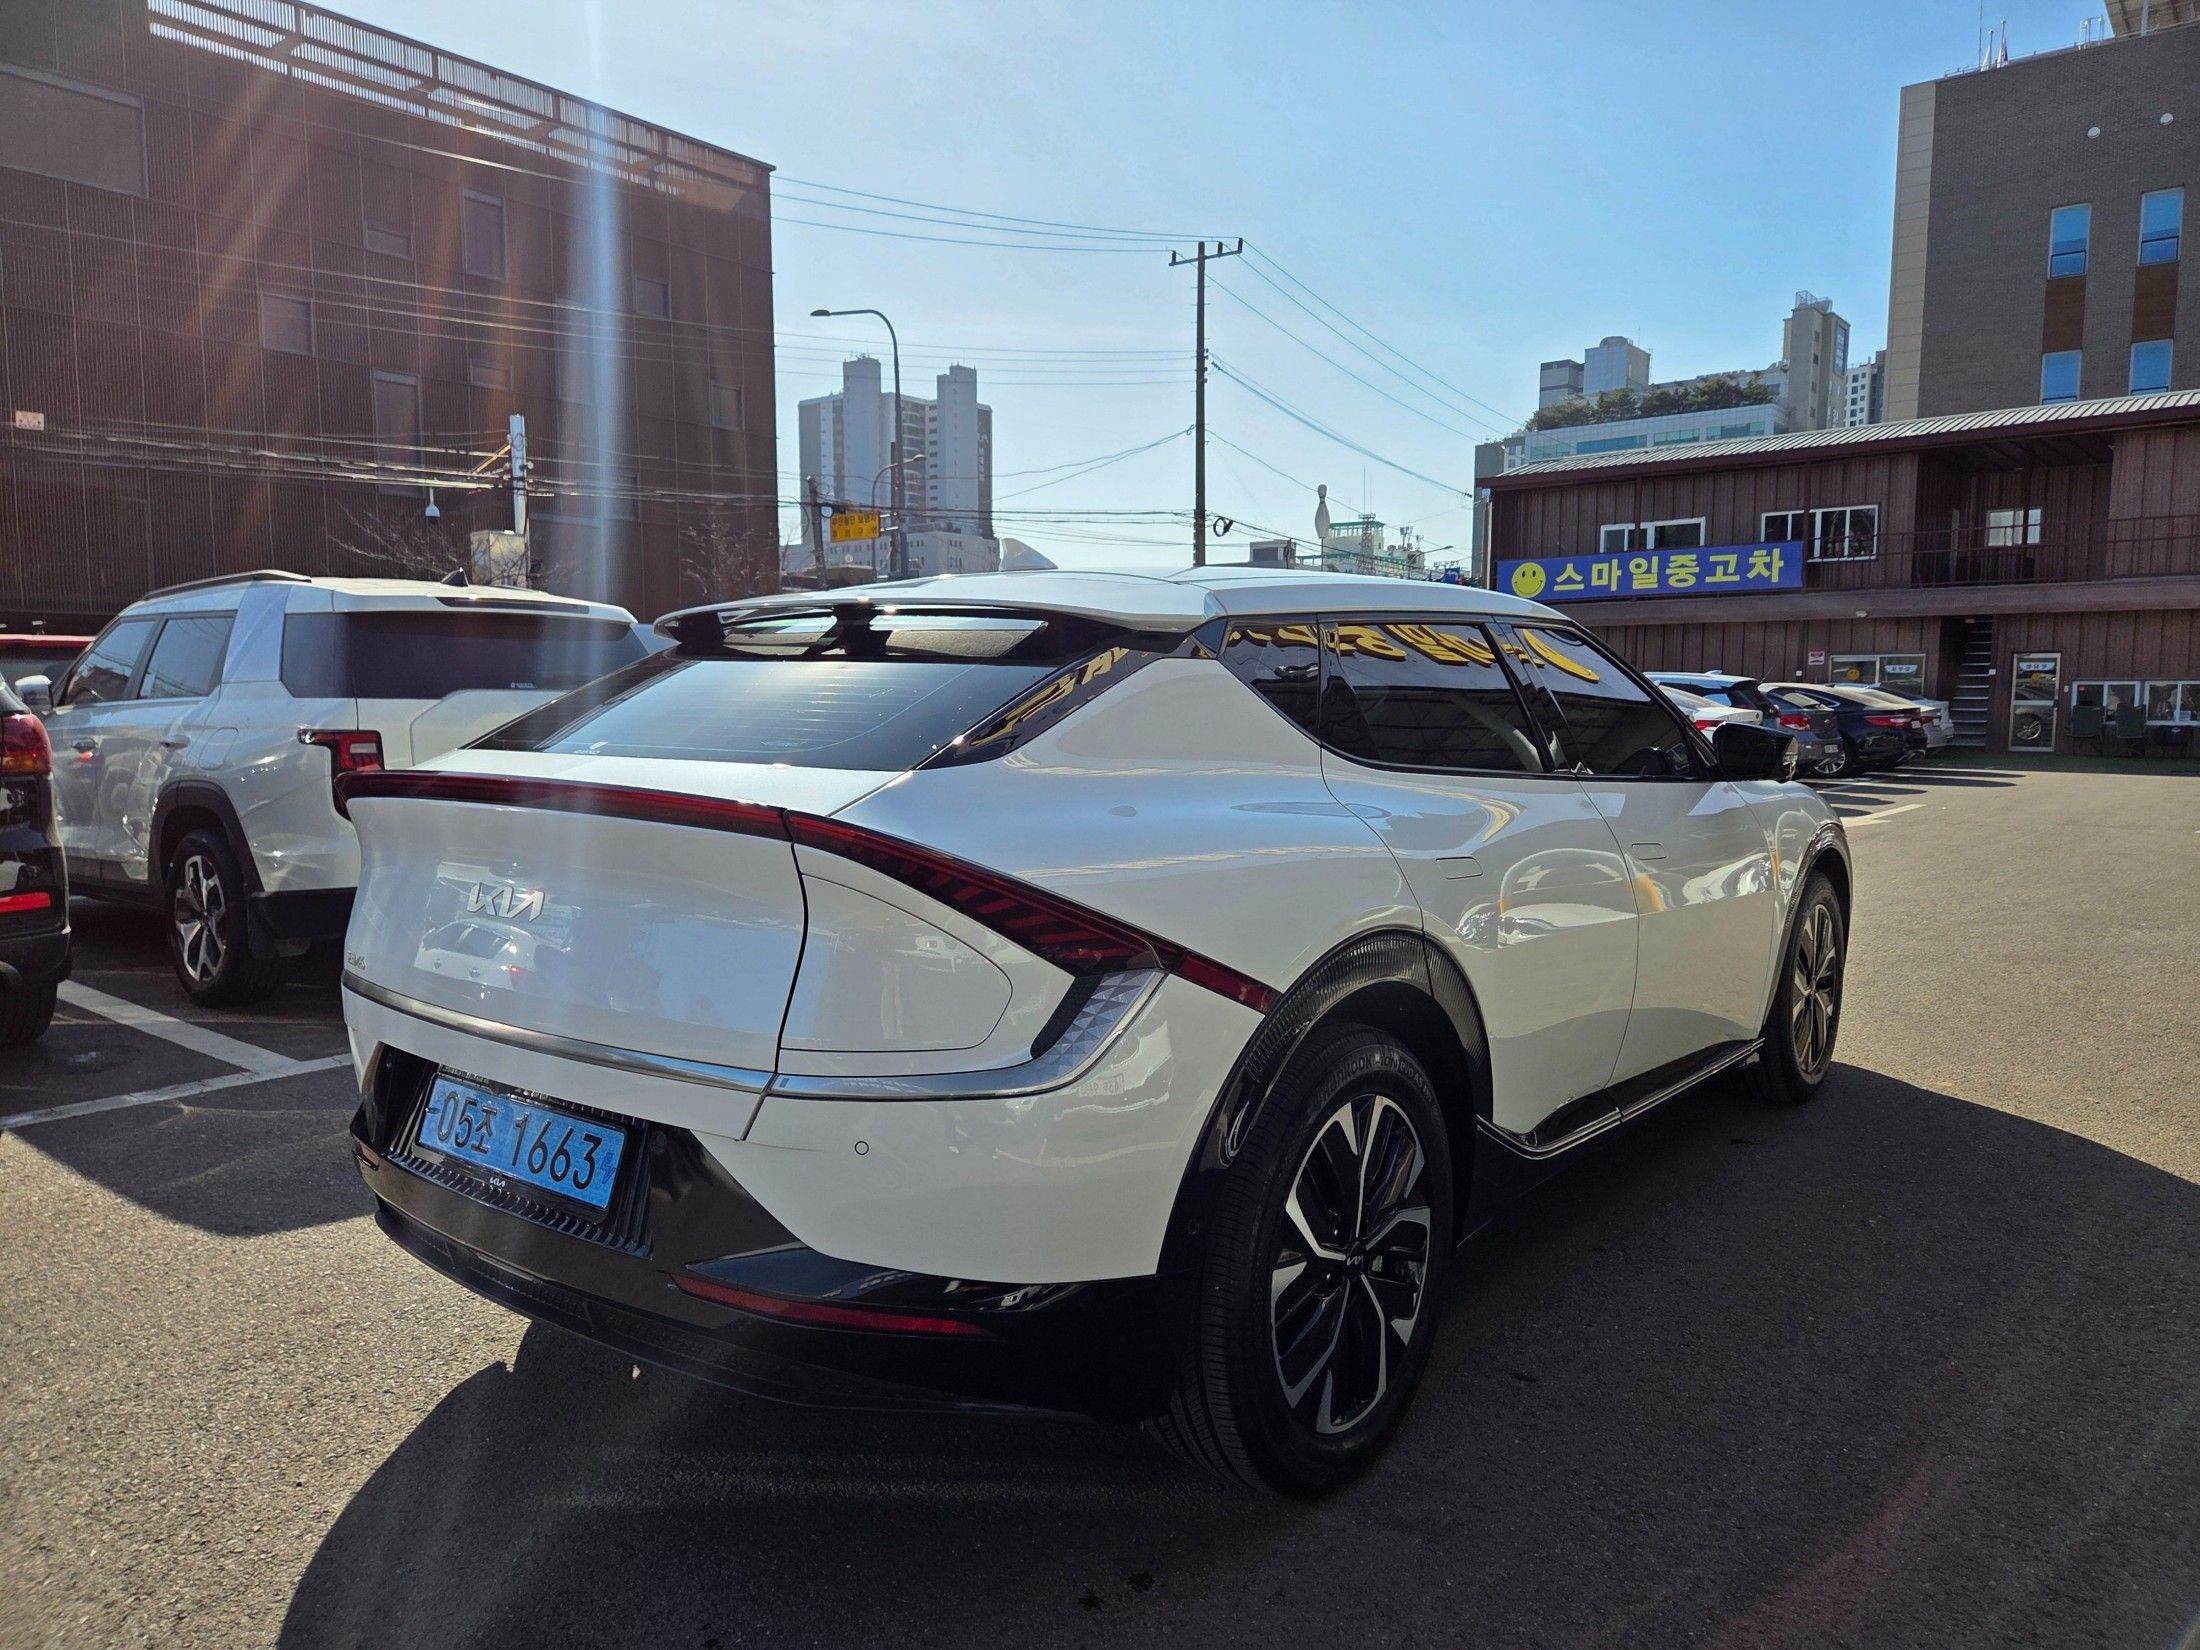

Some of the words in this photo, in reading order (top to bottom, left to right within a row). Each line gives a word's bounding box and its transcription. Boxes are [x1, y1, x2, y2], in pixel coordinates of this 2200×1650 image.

[1553, 548, 1784, 591] 스마일중고차
[467, 881, 546, 922] KIA
[437, 1090, 498, 1154] 05조
[511, 1112, 602, 1189] 1663
